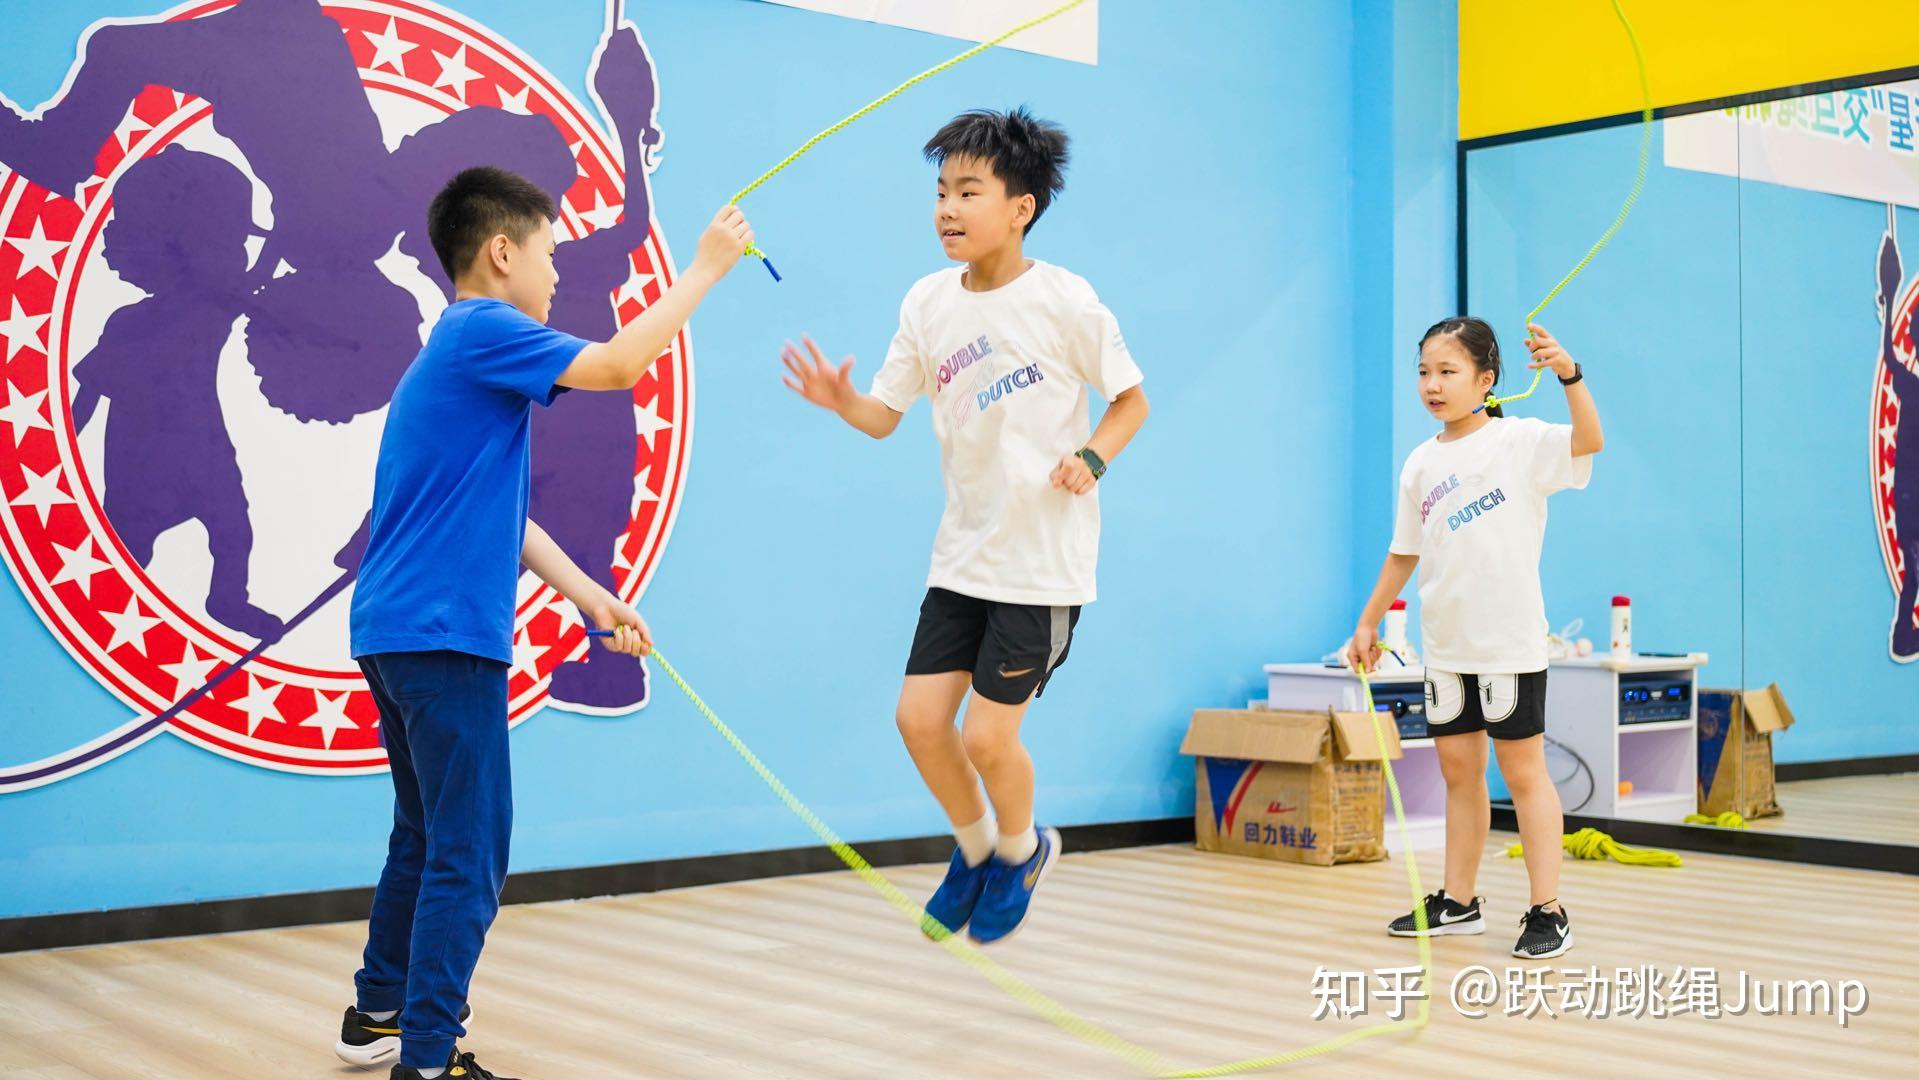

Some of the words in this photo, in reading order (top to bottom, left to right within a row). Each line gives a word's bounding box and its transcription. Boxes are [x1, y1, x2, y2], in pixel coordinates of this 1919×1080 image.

[977, 363, 1044, 411] DUTCH
[1447, 488, 1506, 531] DUTCH
[1244, 822, 1319, 850] 回力鞋业
